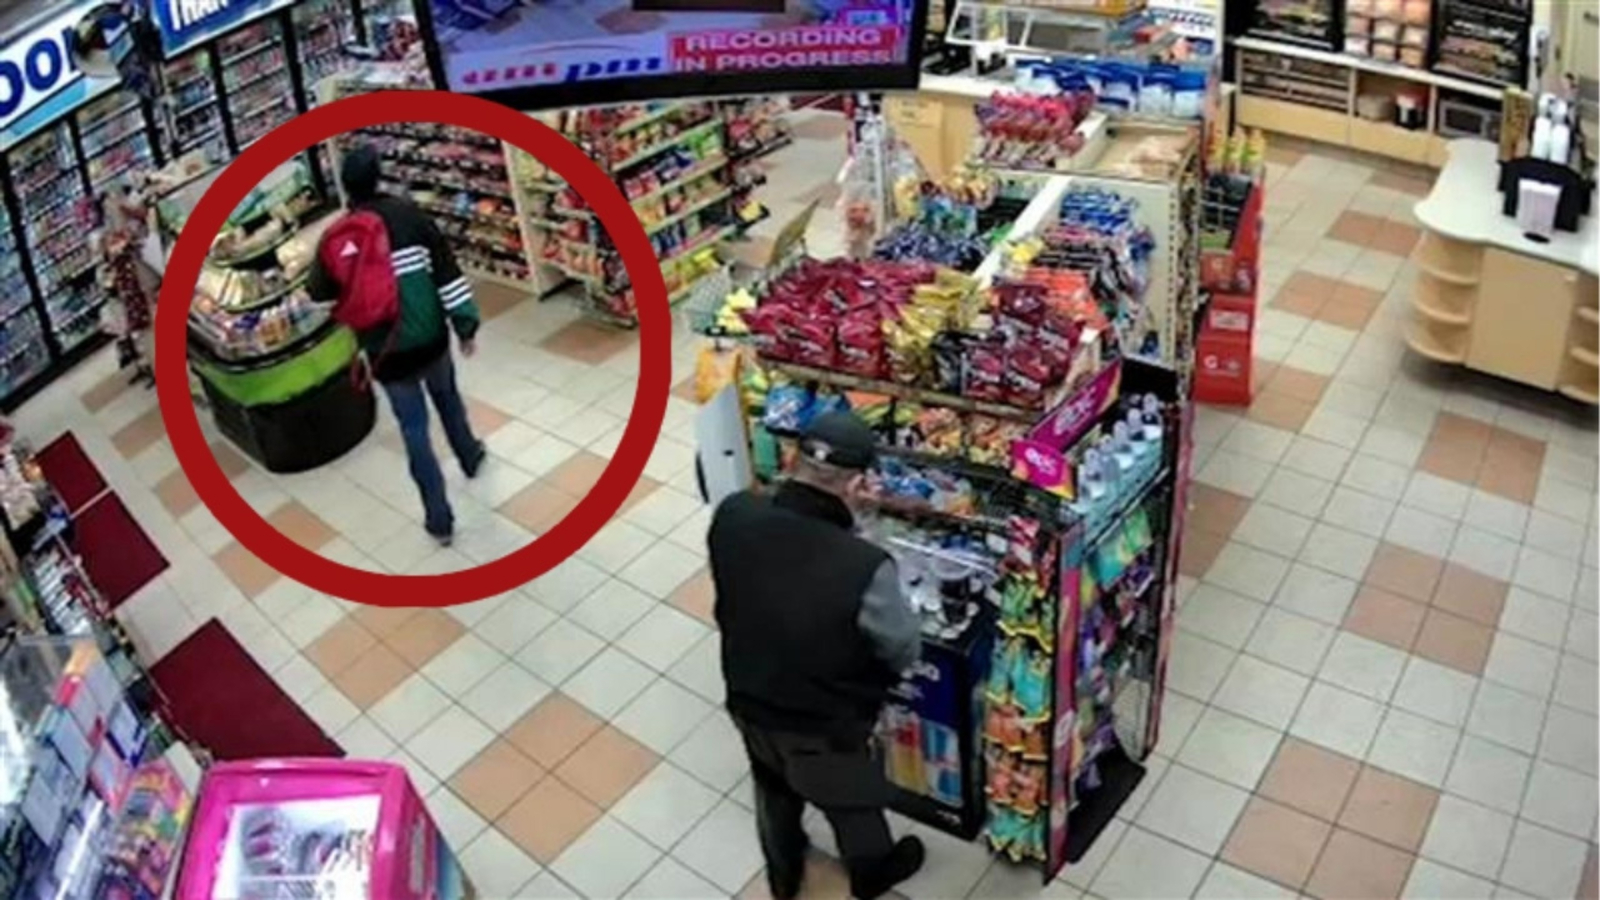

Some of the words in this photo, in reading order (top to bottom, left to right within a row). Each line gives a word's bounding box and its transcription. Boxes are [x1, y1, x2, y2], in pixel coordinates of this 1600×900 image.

[686, 28, 881, 51] RECORDING
[676, 55, 706, 71] IN
[716, 50, 890, 70] PROGRESS
